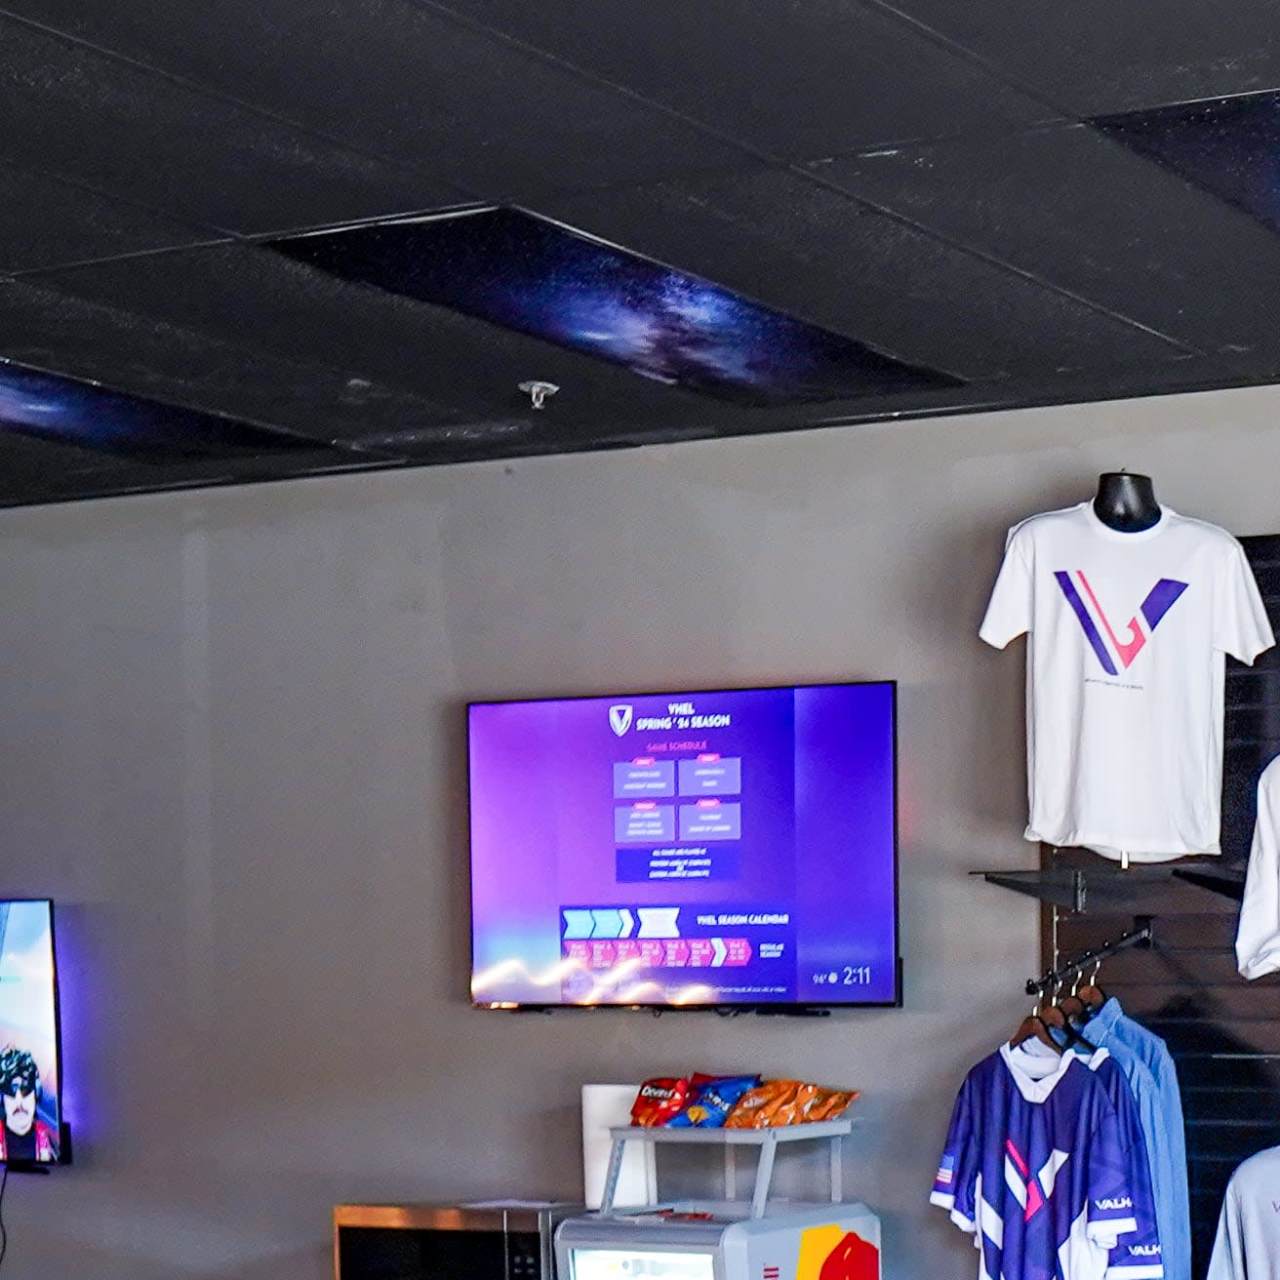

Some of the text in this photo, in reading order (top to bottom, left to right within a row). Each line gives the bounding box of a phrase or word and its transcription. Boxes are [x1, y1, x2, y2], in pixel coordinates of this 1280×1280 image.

[636, 718, 672, 731] SPRING
[691, 714, 731, 728] SEASON
[843, 966, 871, 985] 2:11
